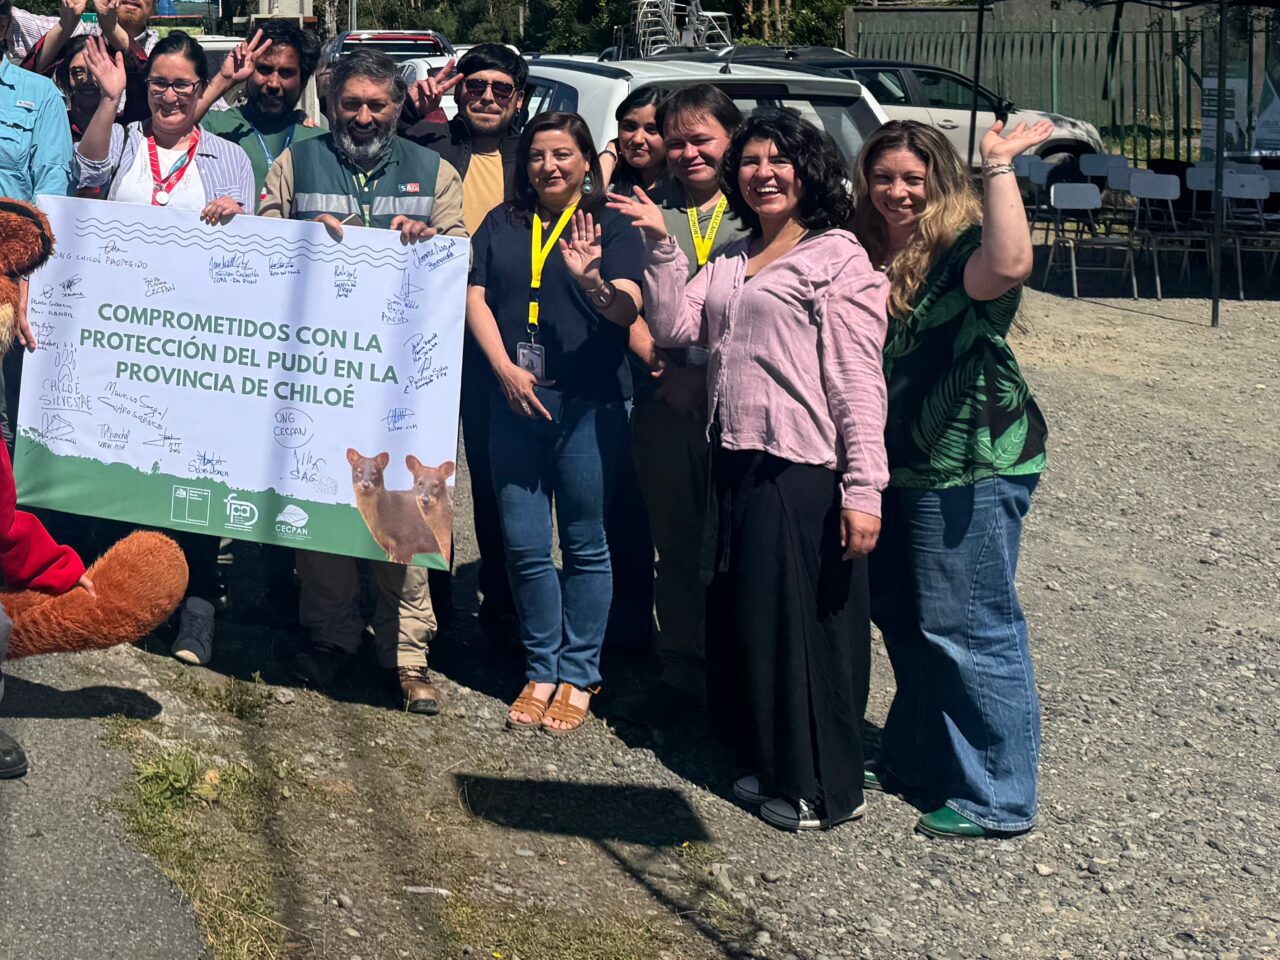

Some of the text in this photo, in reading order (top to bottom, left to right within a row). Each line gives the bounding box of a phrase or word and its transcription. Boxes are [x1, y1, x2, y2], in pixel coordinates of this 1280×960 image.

[98, 303, 290, 342] COMPROMETIDOS
[296, 326, 347, 349] CON
[354, 332, 382, 353] LA
[79, 328, 217, 362] PROTECCIÓN
[223, 345, 260, 367] DEL
[267, 351, 327, 375] PUDÚ
[334, 359, 363, 380] EN
[370, 363, 399, 384] LA
[116, 361, 355, 408] PROVINCIA DE CHILOÉ
[273, 426, 307, 437] CECPAN
[275, 412, 296, 423] ONG
[275, 524, 308, 536] CECPAN
